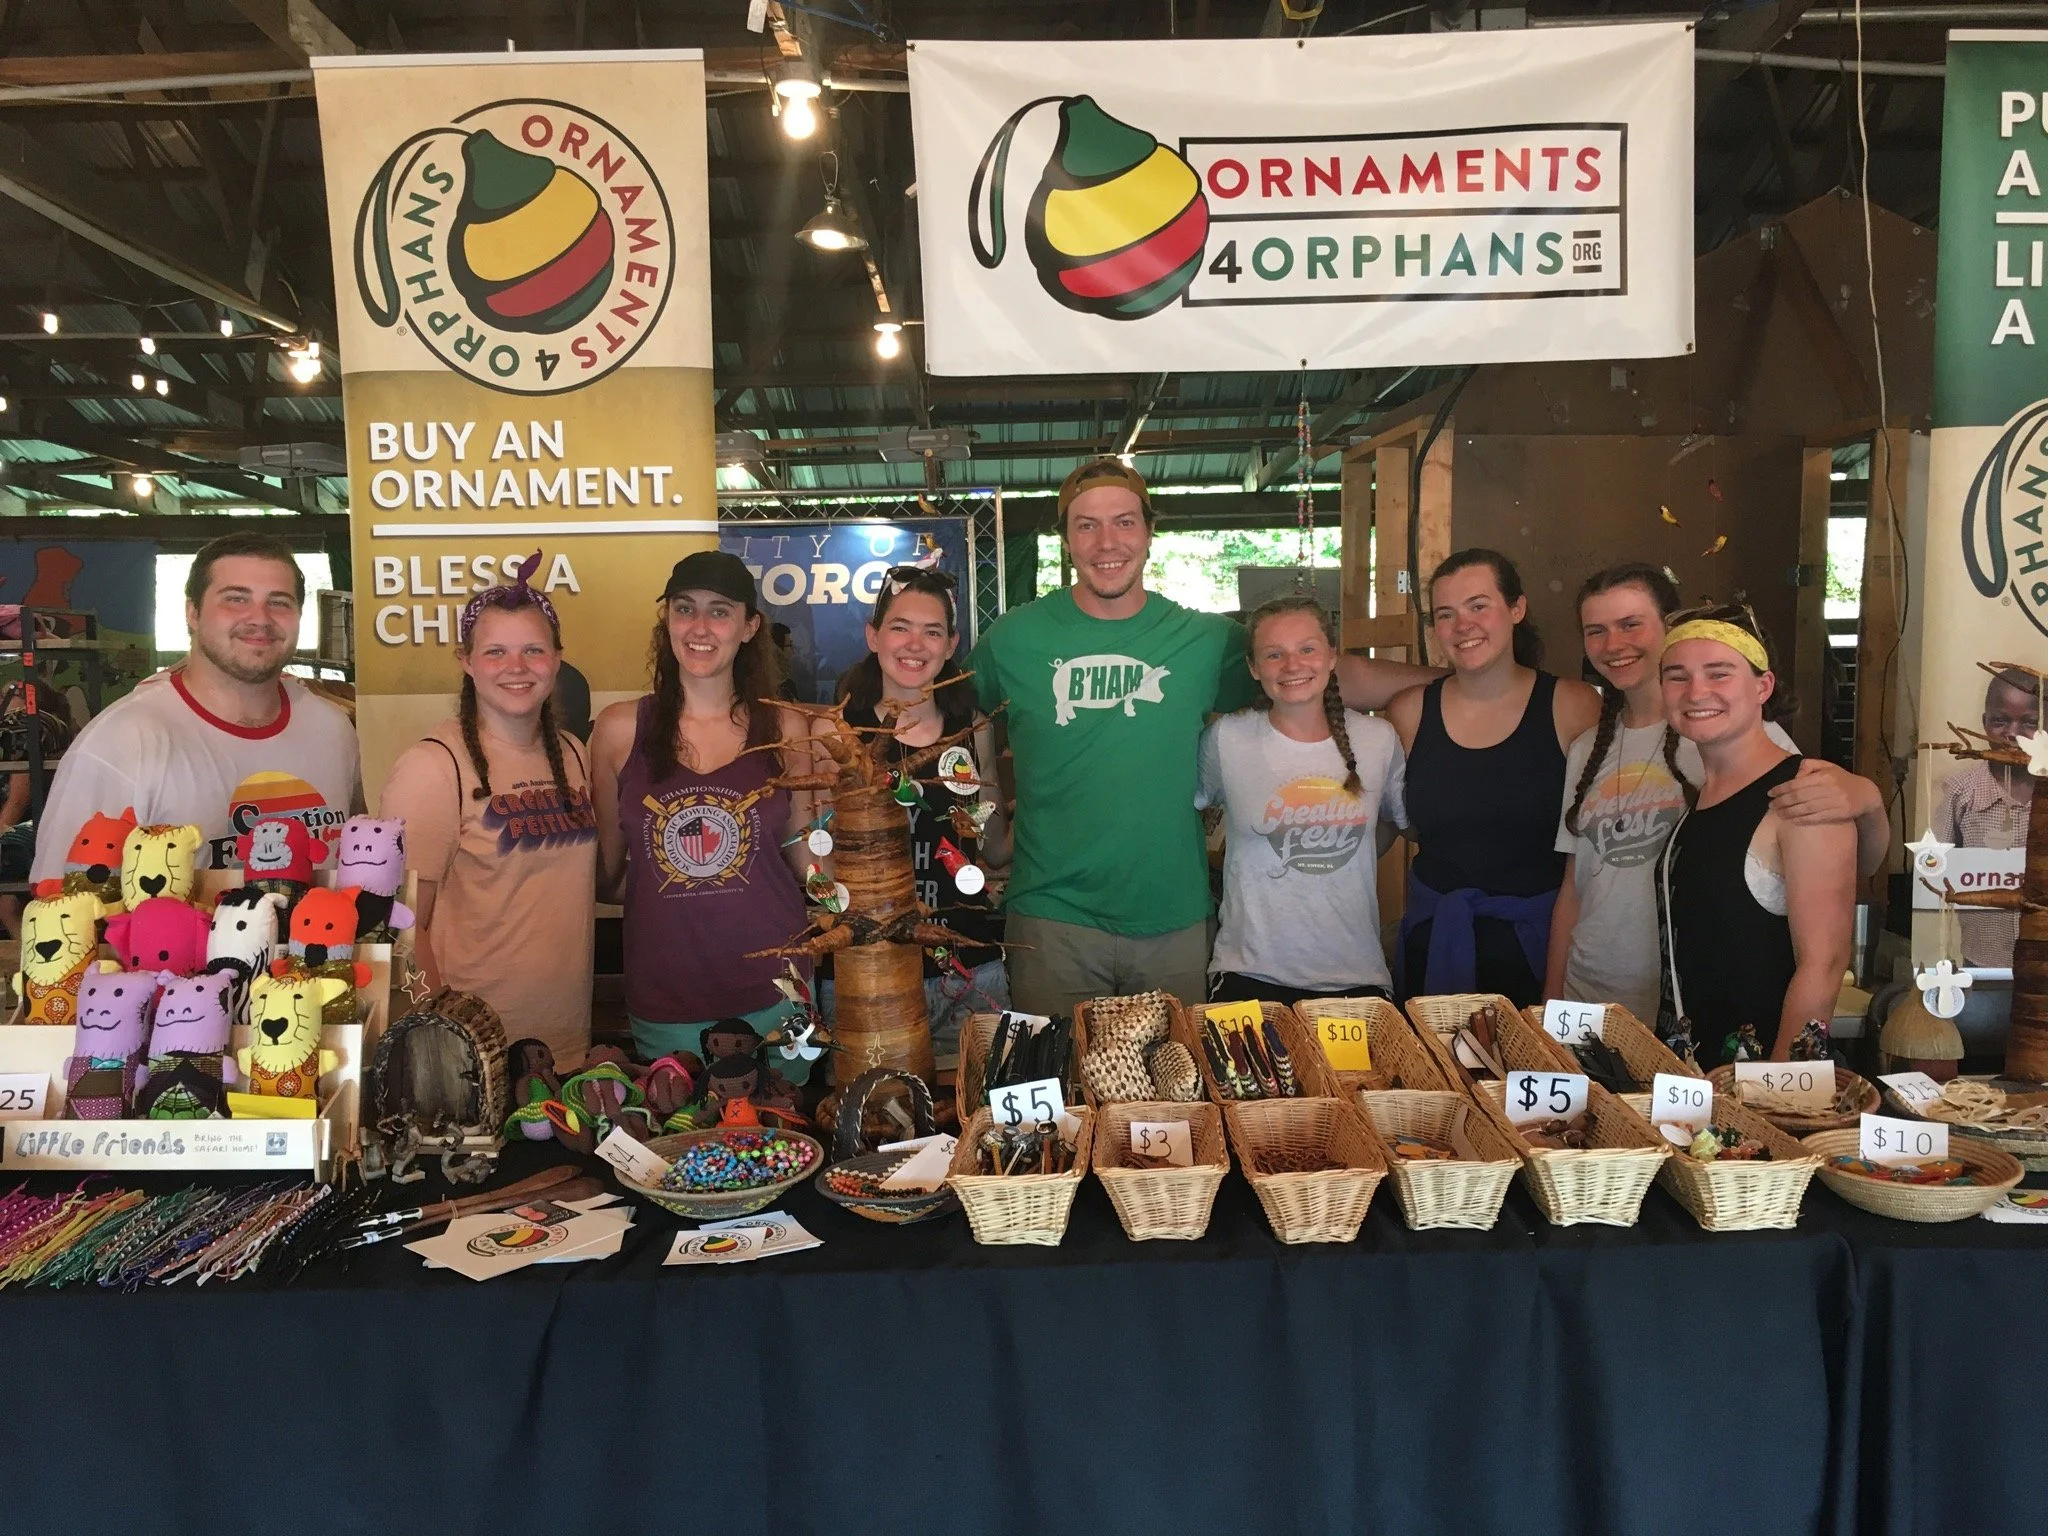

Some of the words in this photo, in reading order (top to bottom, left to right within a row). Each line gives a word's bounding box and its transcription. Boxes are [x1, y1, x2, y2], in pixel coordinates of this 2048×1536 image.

[2000, 91, 2048, 138] P
[1206, 147, 1601, 200] ORNAMENTS
[1996, 150, 2041, 196] A
[521, 114, 661, 369] ORNAMENTS
[1208, 231, 1563, 284] 4ORPHANS
[1572, 240, 1602, 261] ORG
[400, 162, 520, 377] ORPHANS
[1990, 299, 2036, 345] A
[535, 349, 560, 381] 4
[369, 421, 477, 461] BUY
[491, 420, 565, 459] AN
[371, 465, 684, 508] ORNAMENT.
[374, 555, 527, 596] BLESS
[544, 554, 582, 593] A
[746, 561, 918, 606] ORG
[375, 603, 464, 644] CHI
[1068, 664, 1144, 701] B'HAM
[659, 785, 744, 803] CHAMPIONSHIPS
[678, 806, 720, 822] ROWING
[642, 812, 654, 860] NATIONAL
[666, 819, 692, 873] SCHOLASTIC
[717, 814, 738, 869] ASSOCIATION
[749, 807, 761, 852] REGATTA
[1273, 824, 1359, 873] Fest
[1327, 1022, 1363, 1043] $10
[1556, 1009, 1593, 1042] $5
[0, 1089, 36, 1110] 25
[1517, 1075, 1572, 1114] $5
[1668, 1085, 1704, 1107] $10
[1762, 1071, 1813, 1093] $20
[1897, 1080, 1942, 1100] $15
[1001, 1085, 1054, 1127] $5
[92, 1131, 186, 1156] friends
[194, 1134, 222, 1142] BRING
[229, 1134, 244, 1142] THE
[194, 1144, 228, 1152] SAFARI
[606, 1143, 640, 1174] $4
[1139, 1126, 1172, 1159] $3
[1873, 1126, 1932, 1156] $10
